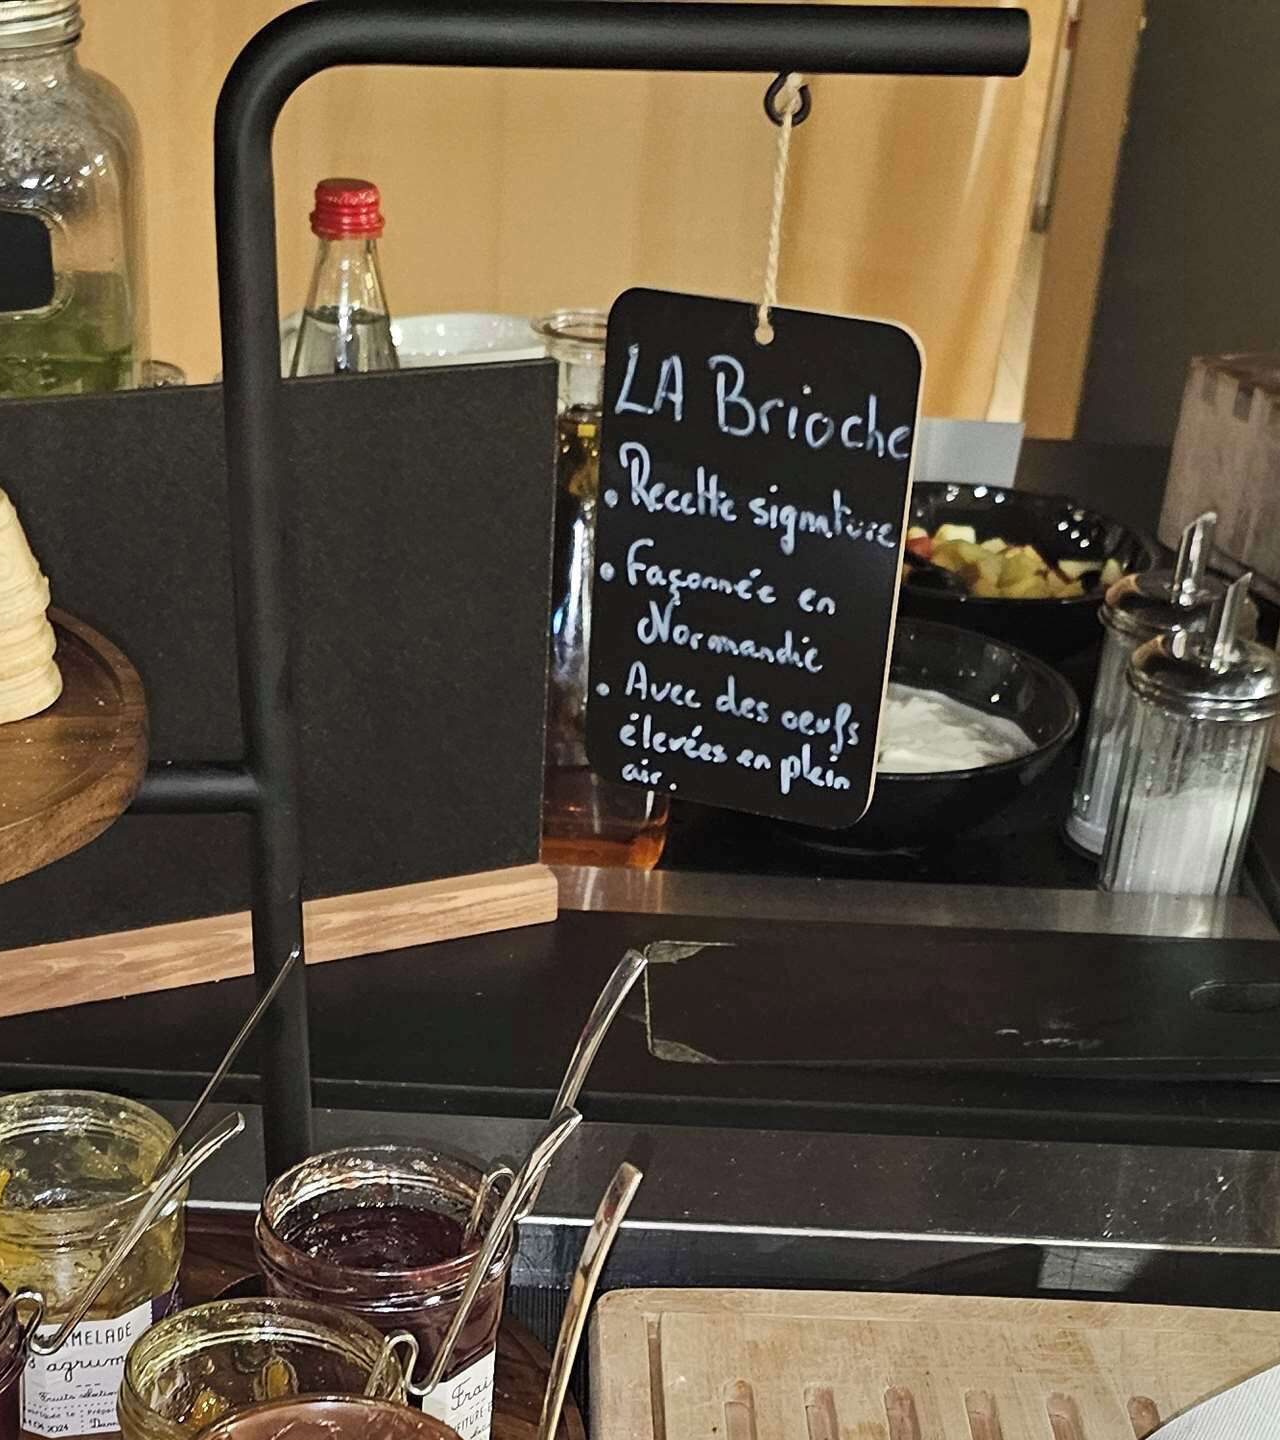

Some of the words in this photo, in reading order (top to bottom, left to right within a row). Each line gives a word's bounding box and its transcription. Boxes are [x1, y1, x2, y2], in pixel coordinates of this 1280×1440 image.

[614, 342, 684, 422] LA
[707, 353, 911, 460] Brioche
[619, 440, 738, 522] Recette
[626, 537, 777, 607] Façonnée
[797, 587, 837, 616] en
[636, 600, 824, 674] Normandie
[624, 660, 702, 709] Avec
[714, 673, 770, 724] des
[780, 702, 861, 755] oeufs
[735, 748, 772, 771] en
[780, 743, 851, 796] plein
